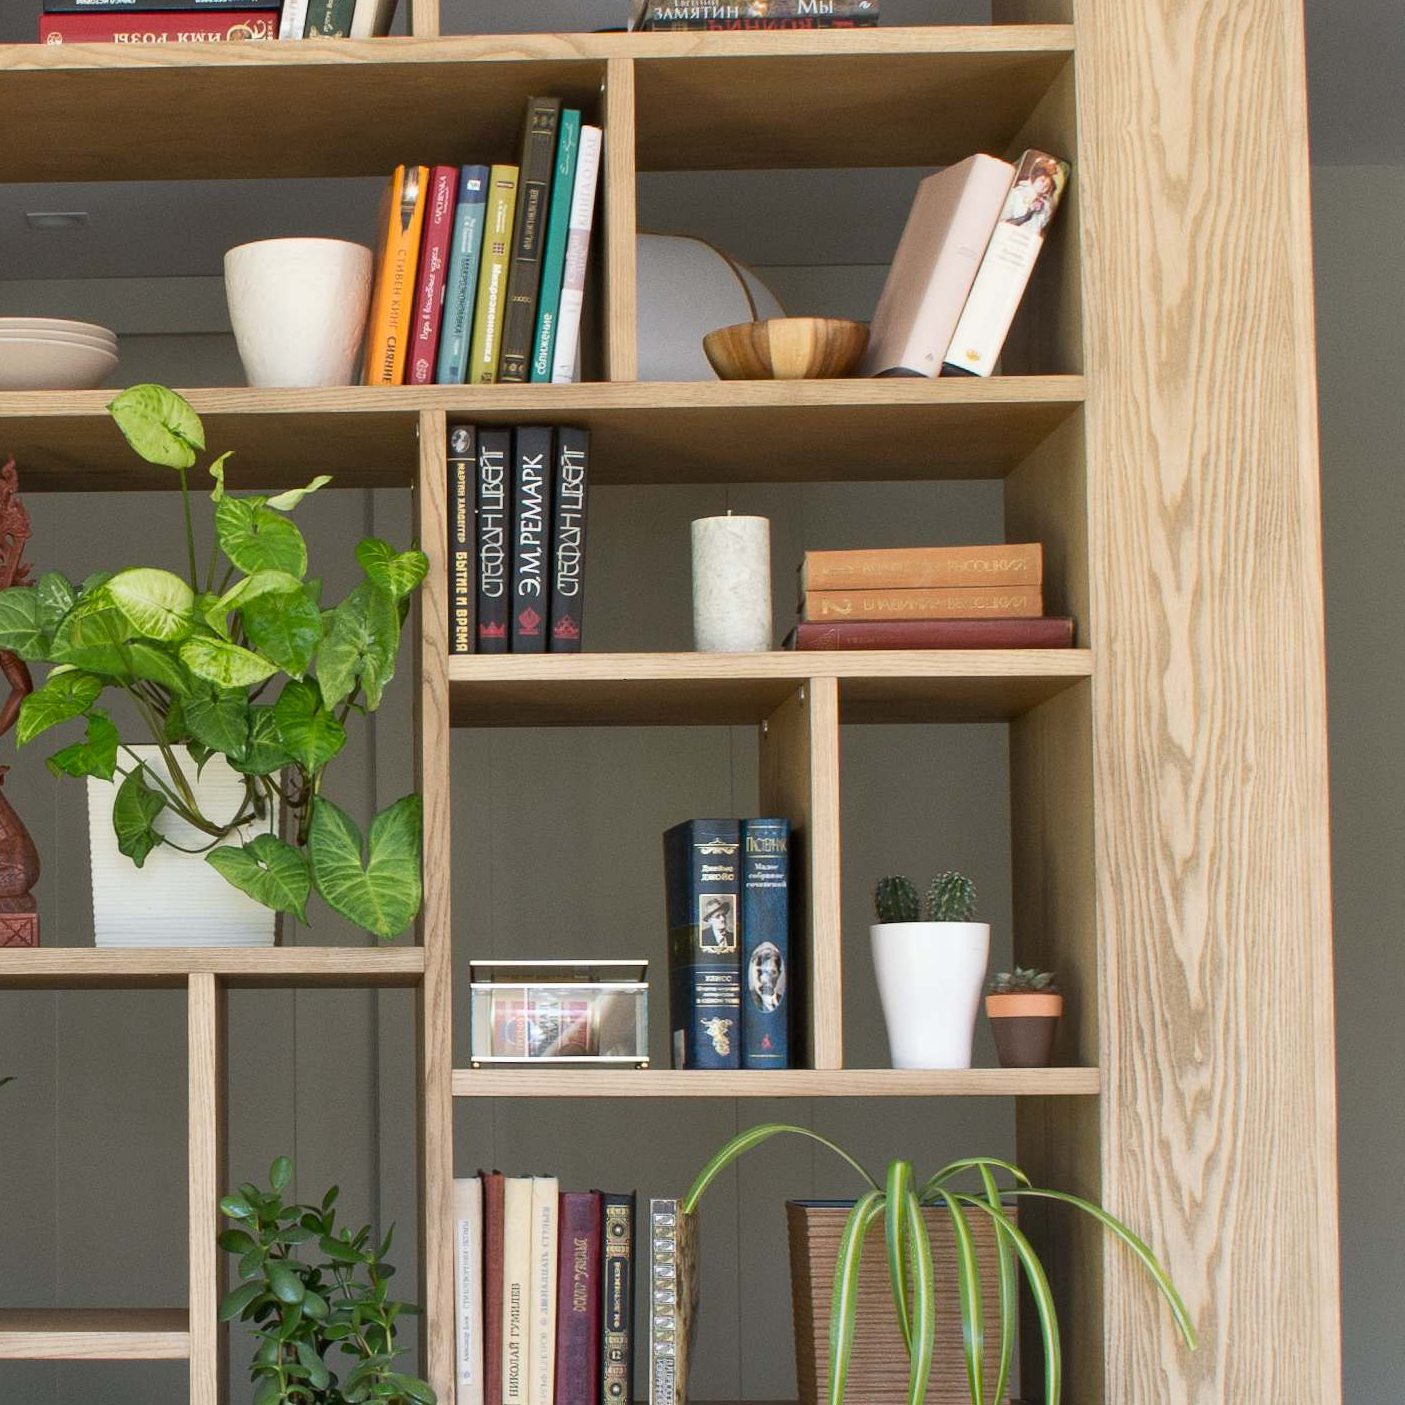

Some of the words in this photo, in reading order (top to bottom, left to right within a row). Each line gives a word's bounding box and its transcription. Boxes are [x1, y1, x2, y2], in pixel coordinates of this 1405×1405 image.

[653, 6, 740, 20] ЗАМЯТИН
[114, 32, 167, 44] РОЗЫ
[176, 32, 221, 43] ИМЯ
[391, 248, 408, 296] СТИВЕН
[388, 299, 404, 330] КИНГ
[483, 263, 503, 364] Микроэкономика
[381, 335, 397, 383] СИЯНИЕ
[535, 312, 553, 376] сближение
[456, 552, 468, 594] БЫТИЕ
[456, 596, 468, 605] И
[456, 608, 468, 653] ВРЕМЯ
[509, 1282, 521, 1338] ГУМИЛЕВ
[507, 1341, 520, 1398] НИКОЛАЙ
